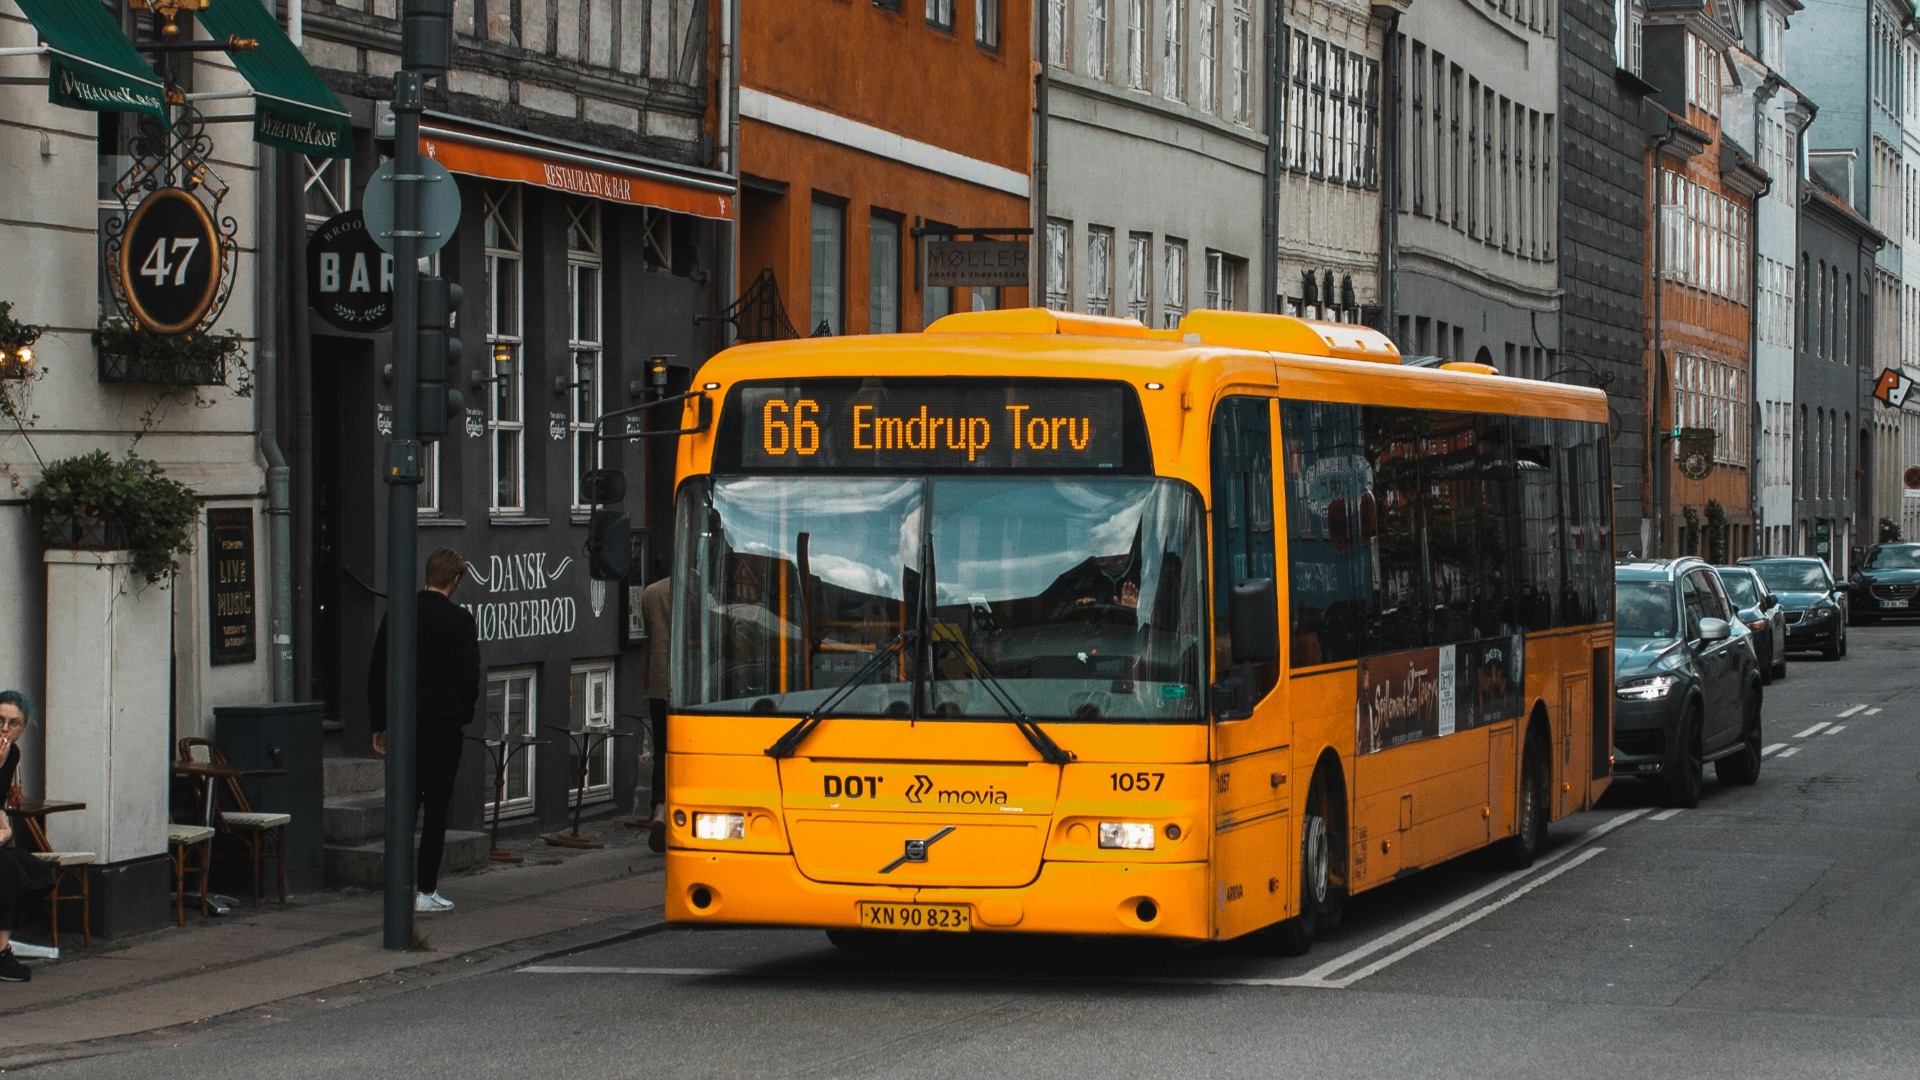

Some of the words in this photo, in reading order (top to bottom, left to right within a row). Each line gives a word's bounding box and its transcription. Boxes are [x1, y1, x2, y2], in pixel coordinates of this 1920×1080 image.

[543, 163, 603, 195] RESTAURANT
[604, 175, 612, 197] &
[612, 177, 631, 200] BAR
[324, 220, 367, 241] BROO
[140, 237, 199, 286] 47
[928, 249, 1027, 267] MØLLER
[320, 252, 394, 292] BAR
[763, 399, 819, 455] 66
[853, 405, 990, 461] Emdrup
[1005, 405, 1089, 450] Torv
[219, 560, 246, 583] LIVE
[490, 552, 547, 592] DANSK
[217, 591, 251, 616] MUSIC
[460, 597, 576, 641] MØRREBRØD
[824, 775, 880, 798] DOT
[1110, 772, 1164, 792] 1057
[1217, 773, 1230, 794] 1057
[938, 785, 1008, 804] movia
[871, 907, 894, 924] XN
[900, 908, 921, 925] 90
[927, 909, 961, 927] 823
